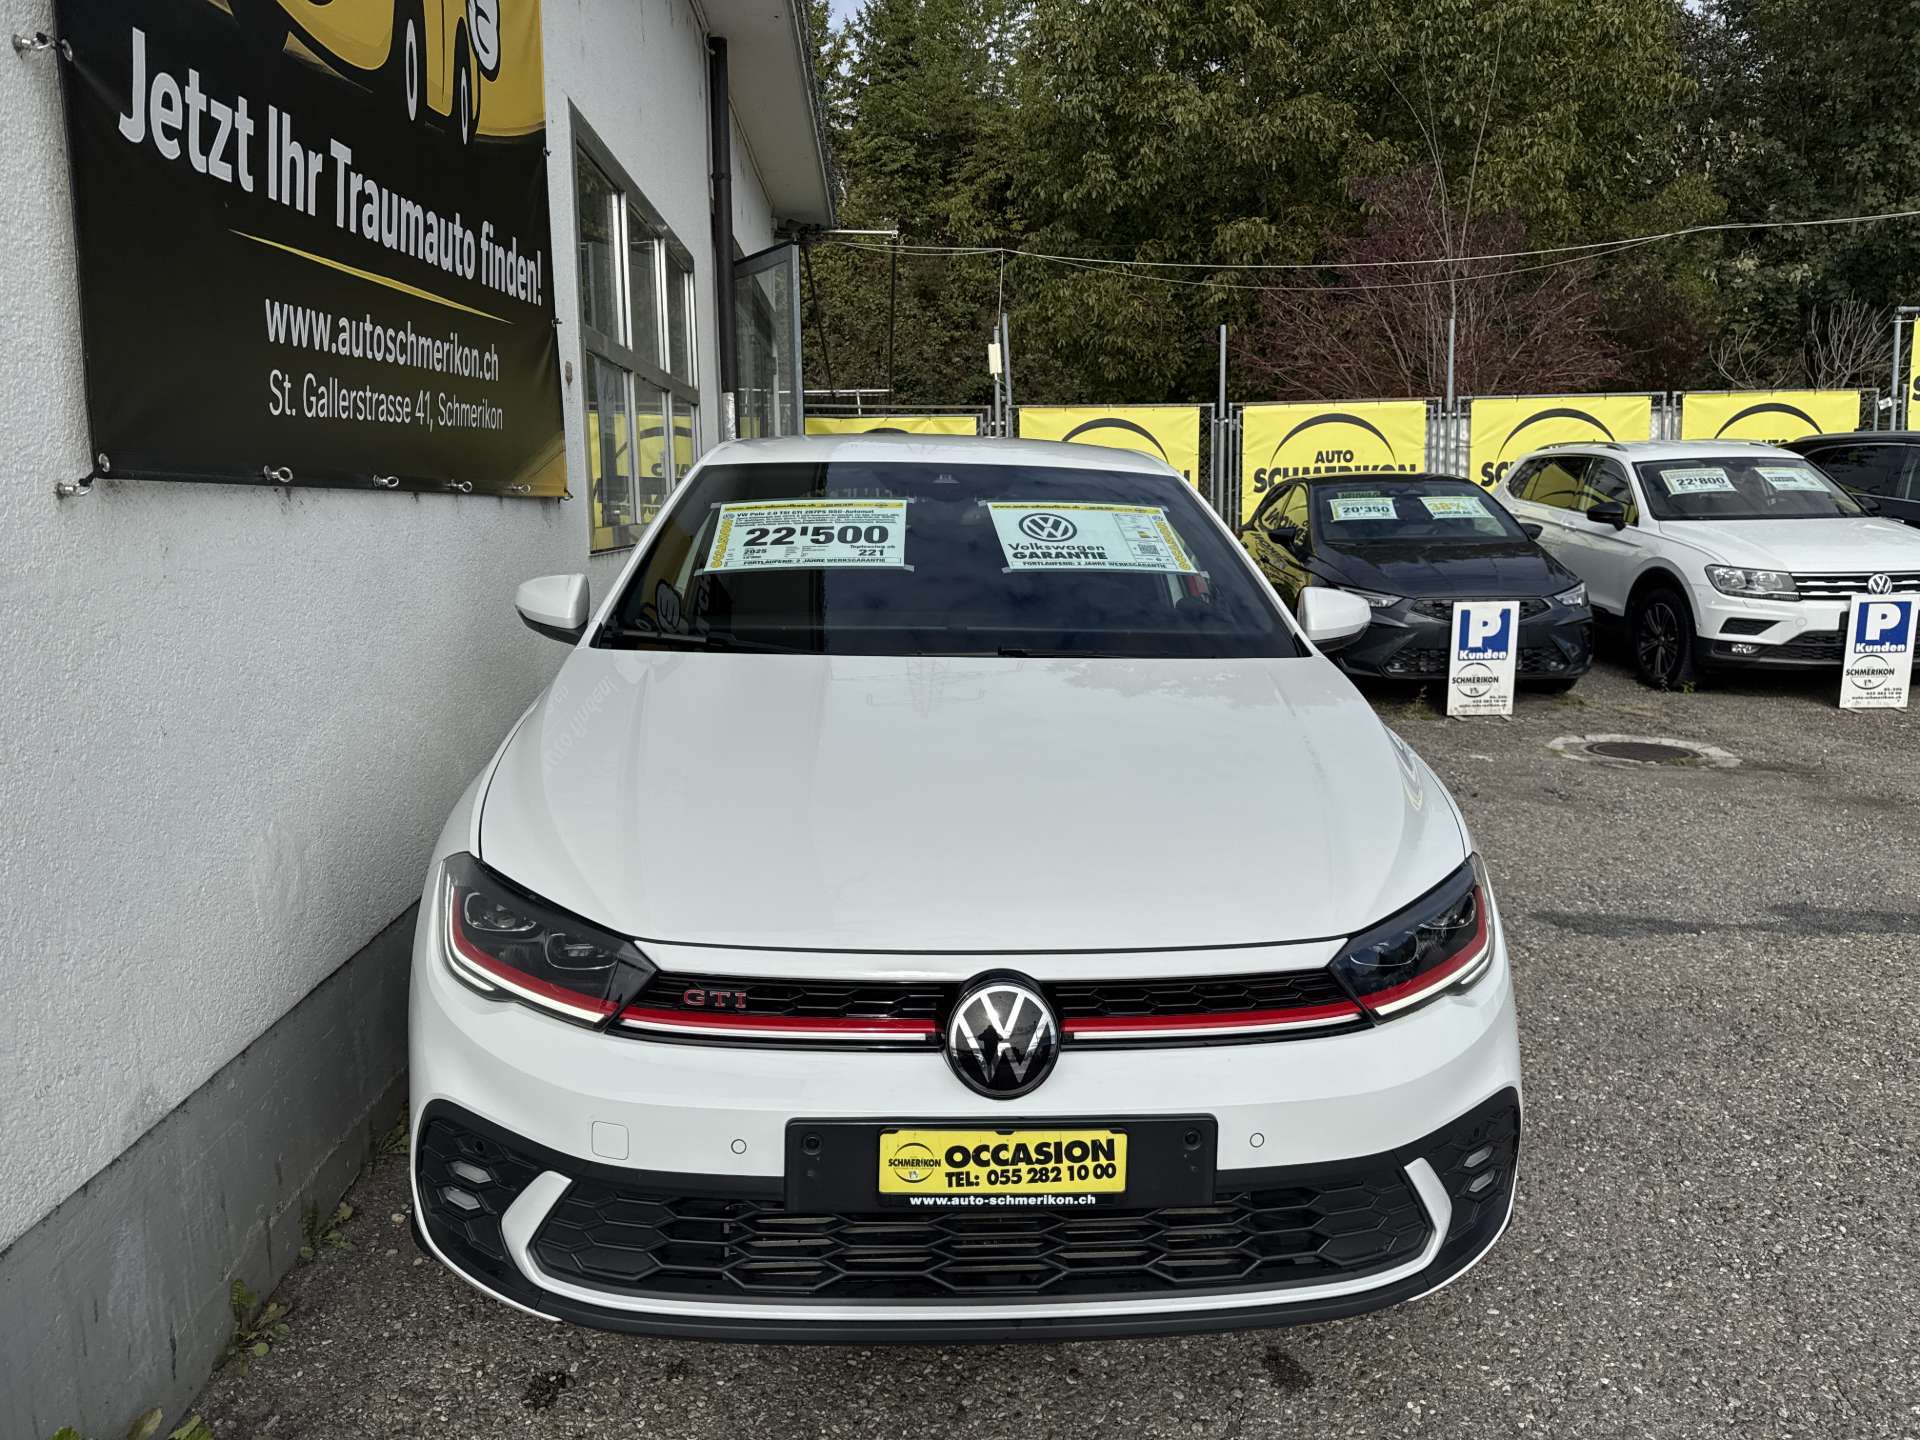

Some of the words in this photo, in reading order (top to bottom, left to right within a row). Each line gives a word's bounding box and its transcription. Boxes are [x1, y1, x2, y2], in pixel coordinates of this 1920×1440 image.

[118, 26, 254, 193] Jetzt
[268, 103, 323, 217] Ihr
[330, 137, 476, 280] Traumauto
[480, 220, 542, 306] finden!
[265, 298, 499, 382] www.autoschmerikon.ch
[269, 368, 296, 417] St.
[303, 372, 411, 424] Gallerstrasse
[415, 389, 433, 432] 41,
[438, 391, 503, 431] Schmerikon
[1314, 449, 1354, 464] AUTO
[1676, 476, 1725, 486] 22'800
[743, 525, 889, 547] 22'500
[1008, 543, 1105, 552] Volkswagen
[1012, 551, 1108, 560] GARANTIE
[1459, 648, 1507, 660] Kunden
[1855, 641, 1906, 653] Kunden
[1845, 668, 1895, 676] SCHMERIKON
[1451, 675, 1499, 684] SCHMERIKON
[682, 988, 747, 1009] GTI
[944, 1138, 1115, 1169] OCCASION
[888, 1158, 942, 1168] SCHMERIKON
[945, 1170, 980, 1188] TEL:
[987, 1168, 1022, 1186] 055
[1026, 1166, 1062, 1184] 282
[1068, 1164, 1089, 1182] 10
[1093, 1163, 1117, 1180] 00
[910, 1193, 1096, 1207] www.auto-schmerikon.ch
